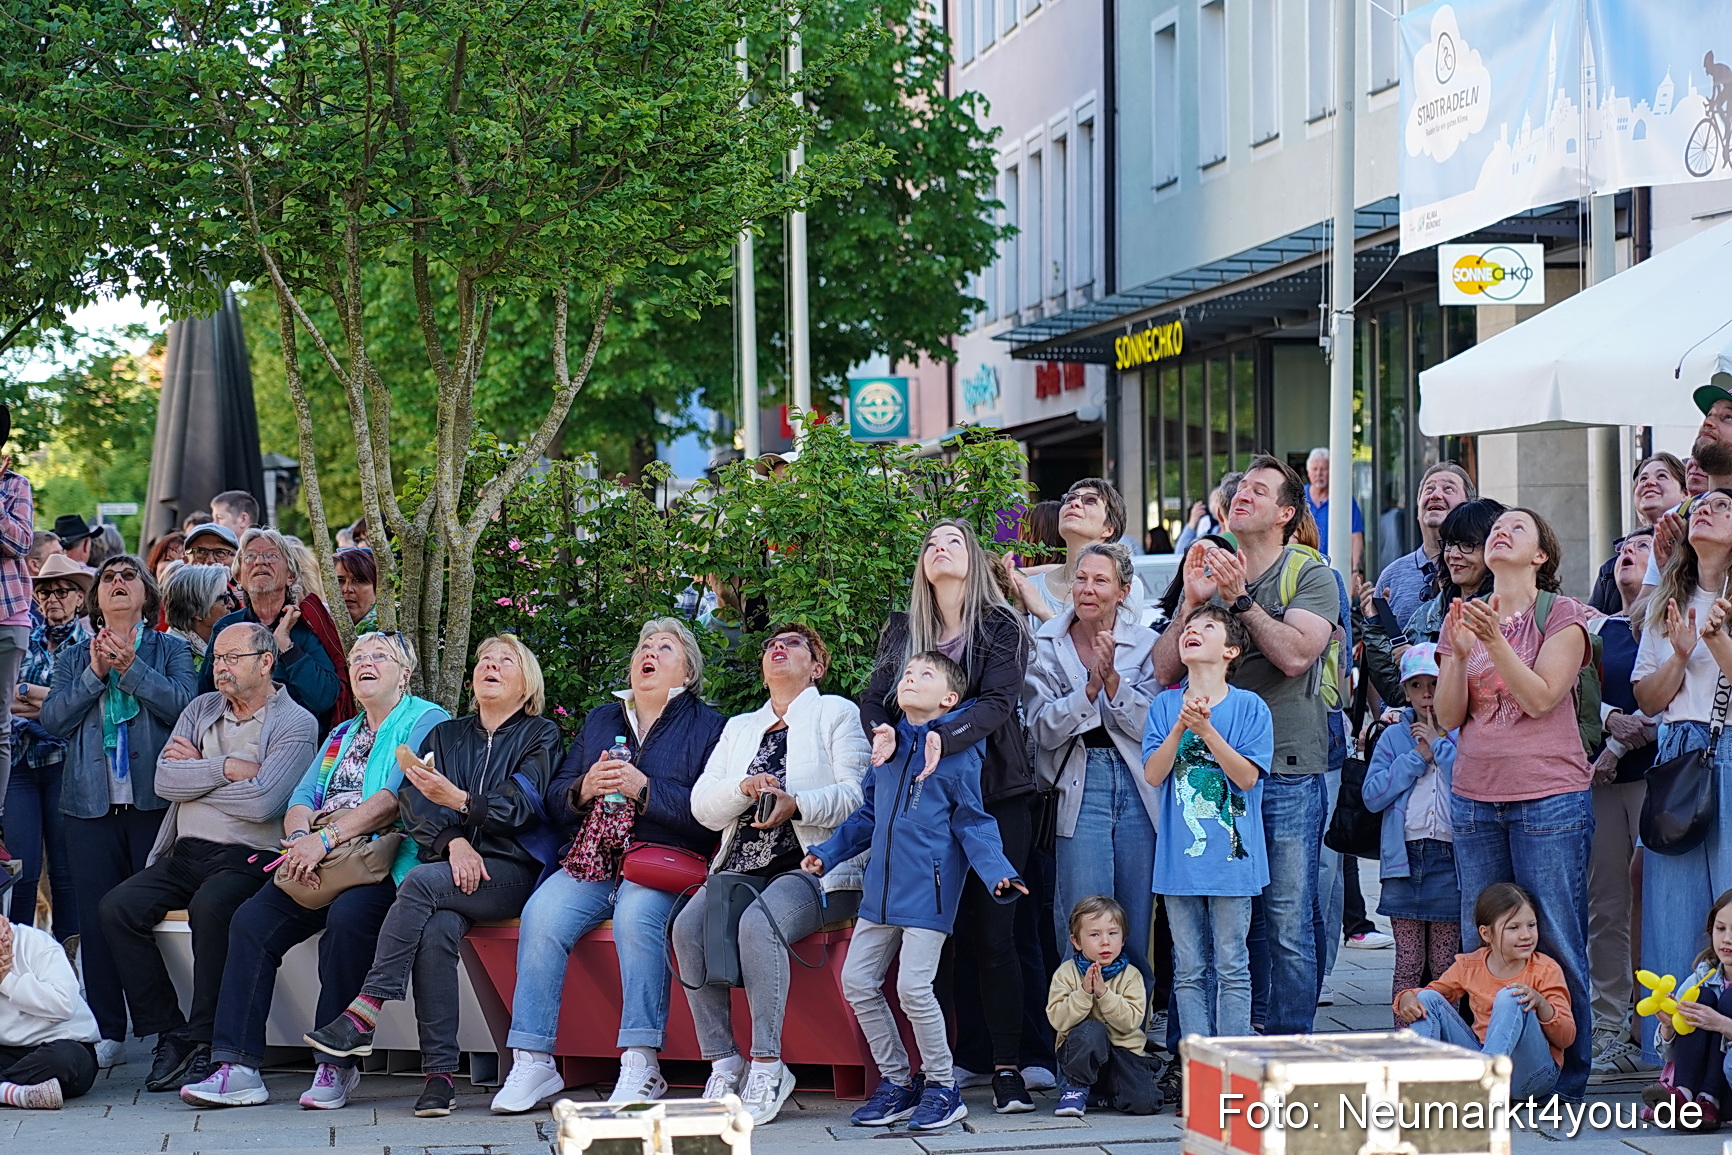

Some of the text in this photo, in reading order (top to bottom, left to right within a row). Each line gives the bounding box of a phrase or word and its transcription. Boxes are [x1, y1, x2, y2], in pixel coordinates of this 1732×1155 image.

[1417, 85, 1480, 126] STADTRADELN
[1452, 265, 1534, 283] SONNECHKO
[1114, 320, 1184, 371] SONNECHKO
[1711, 675, 1732, 724] OOP!
